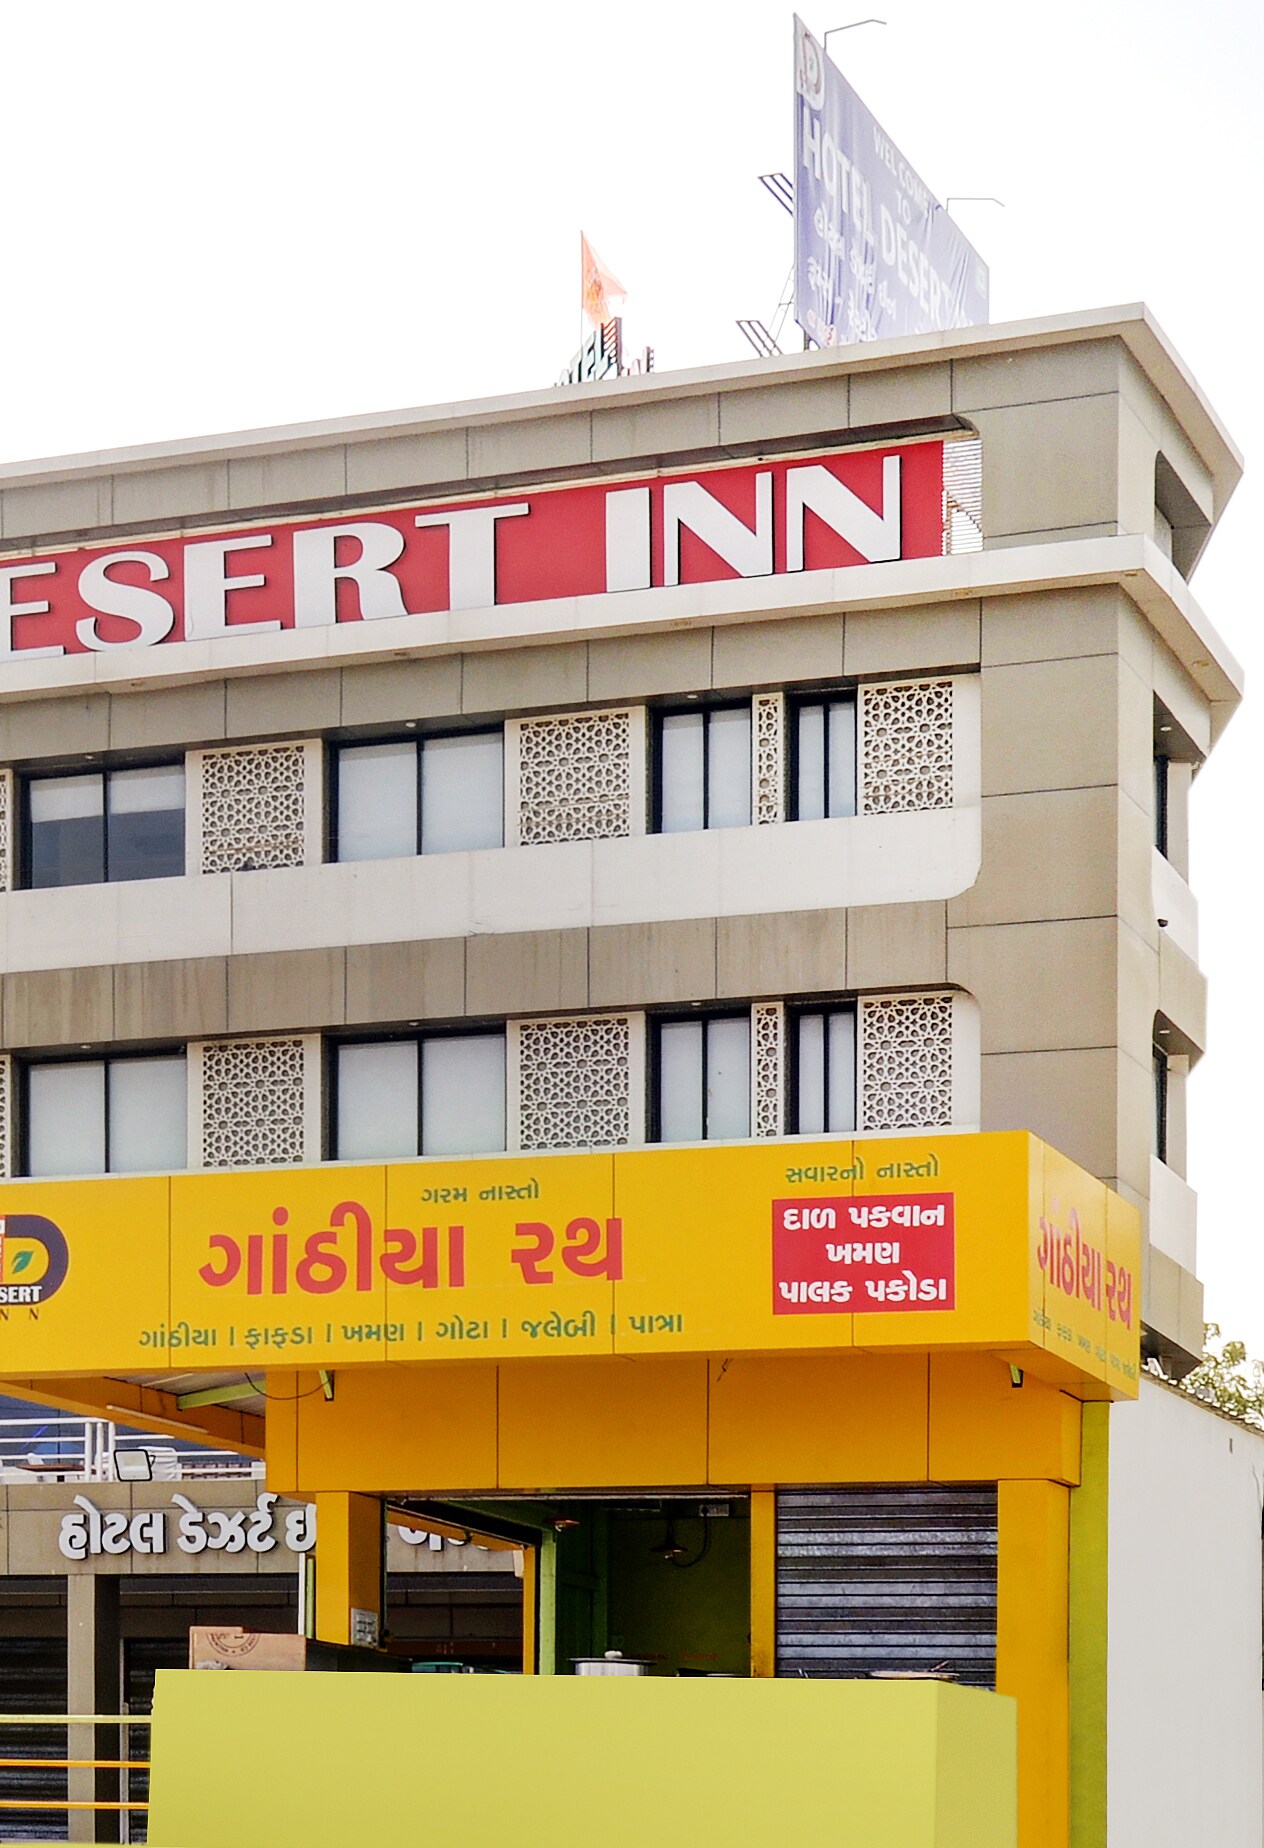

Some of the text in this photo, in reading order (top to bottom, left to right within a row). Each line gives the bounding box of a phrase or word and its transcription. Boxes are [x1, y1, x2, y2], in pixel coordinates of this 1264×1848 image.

[802, 102, 874, 247] HOTEL
[896, 190, 910, 224] TO
[605, 455, 902, 593] INN
[785, 1153, 939, 1184] સવારનો નાસ્તો
[420, 1177, 539, 1203] ગરમ નાસ્તો
[782, 1203, 946, 1231] દાળ પકવાન
[198, 1200, 624, 1296] ગાંઠીયા રથ
[825, 1241, 901, 1265] ખમણ
[1037, 1197, 1133, 1332] ગાંઠીયા રથ
[778, 1269, 948, 1303] પાલક પકોડા
[138, 1310, 682, 1350] ગાંઠીયા ફાફડા ખમણ ગોટા જલેબી પાત્રા
[58, 1494, 167, 1560] હોટલ
[171, 1492, 279, 1554] ડેઝર્ટ
